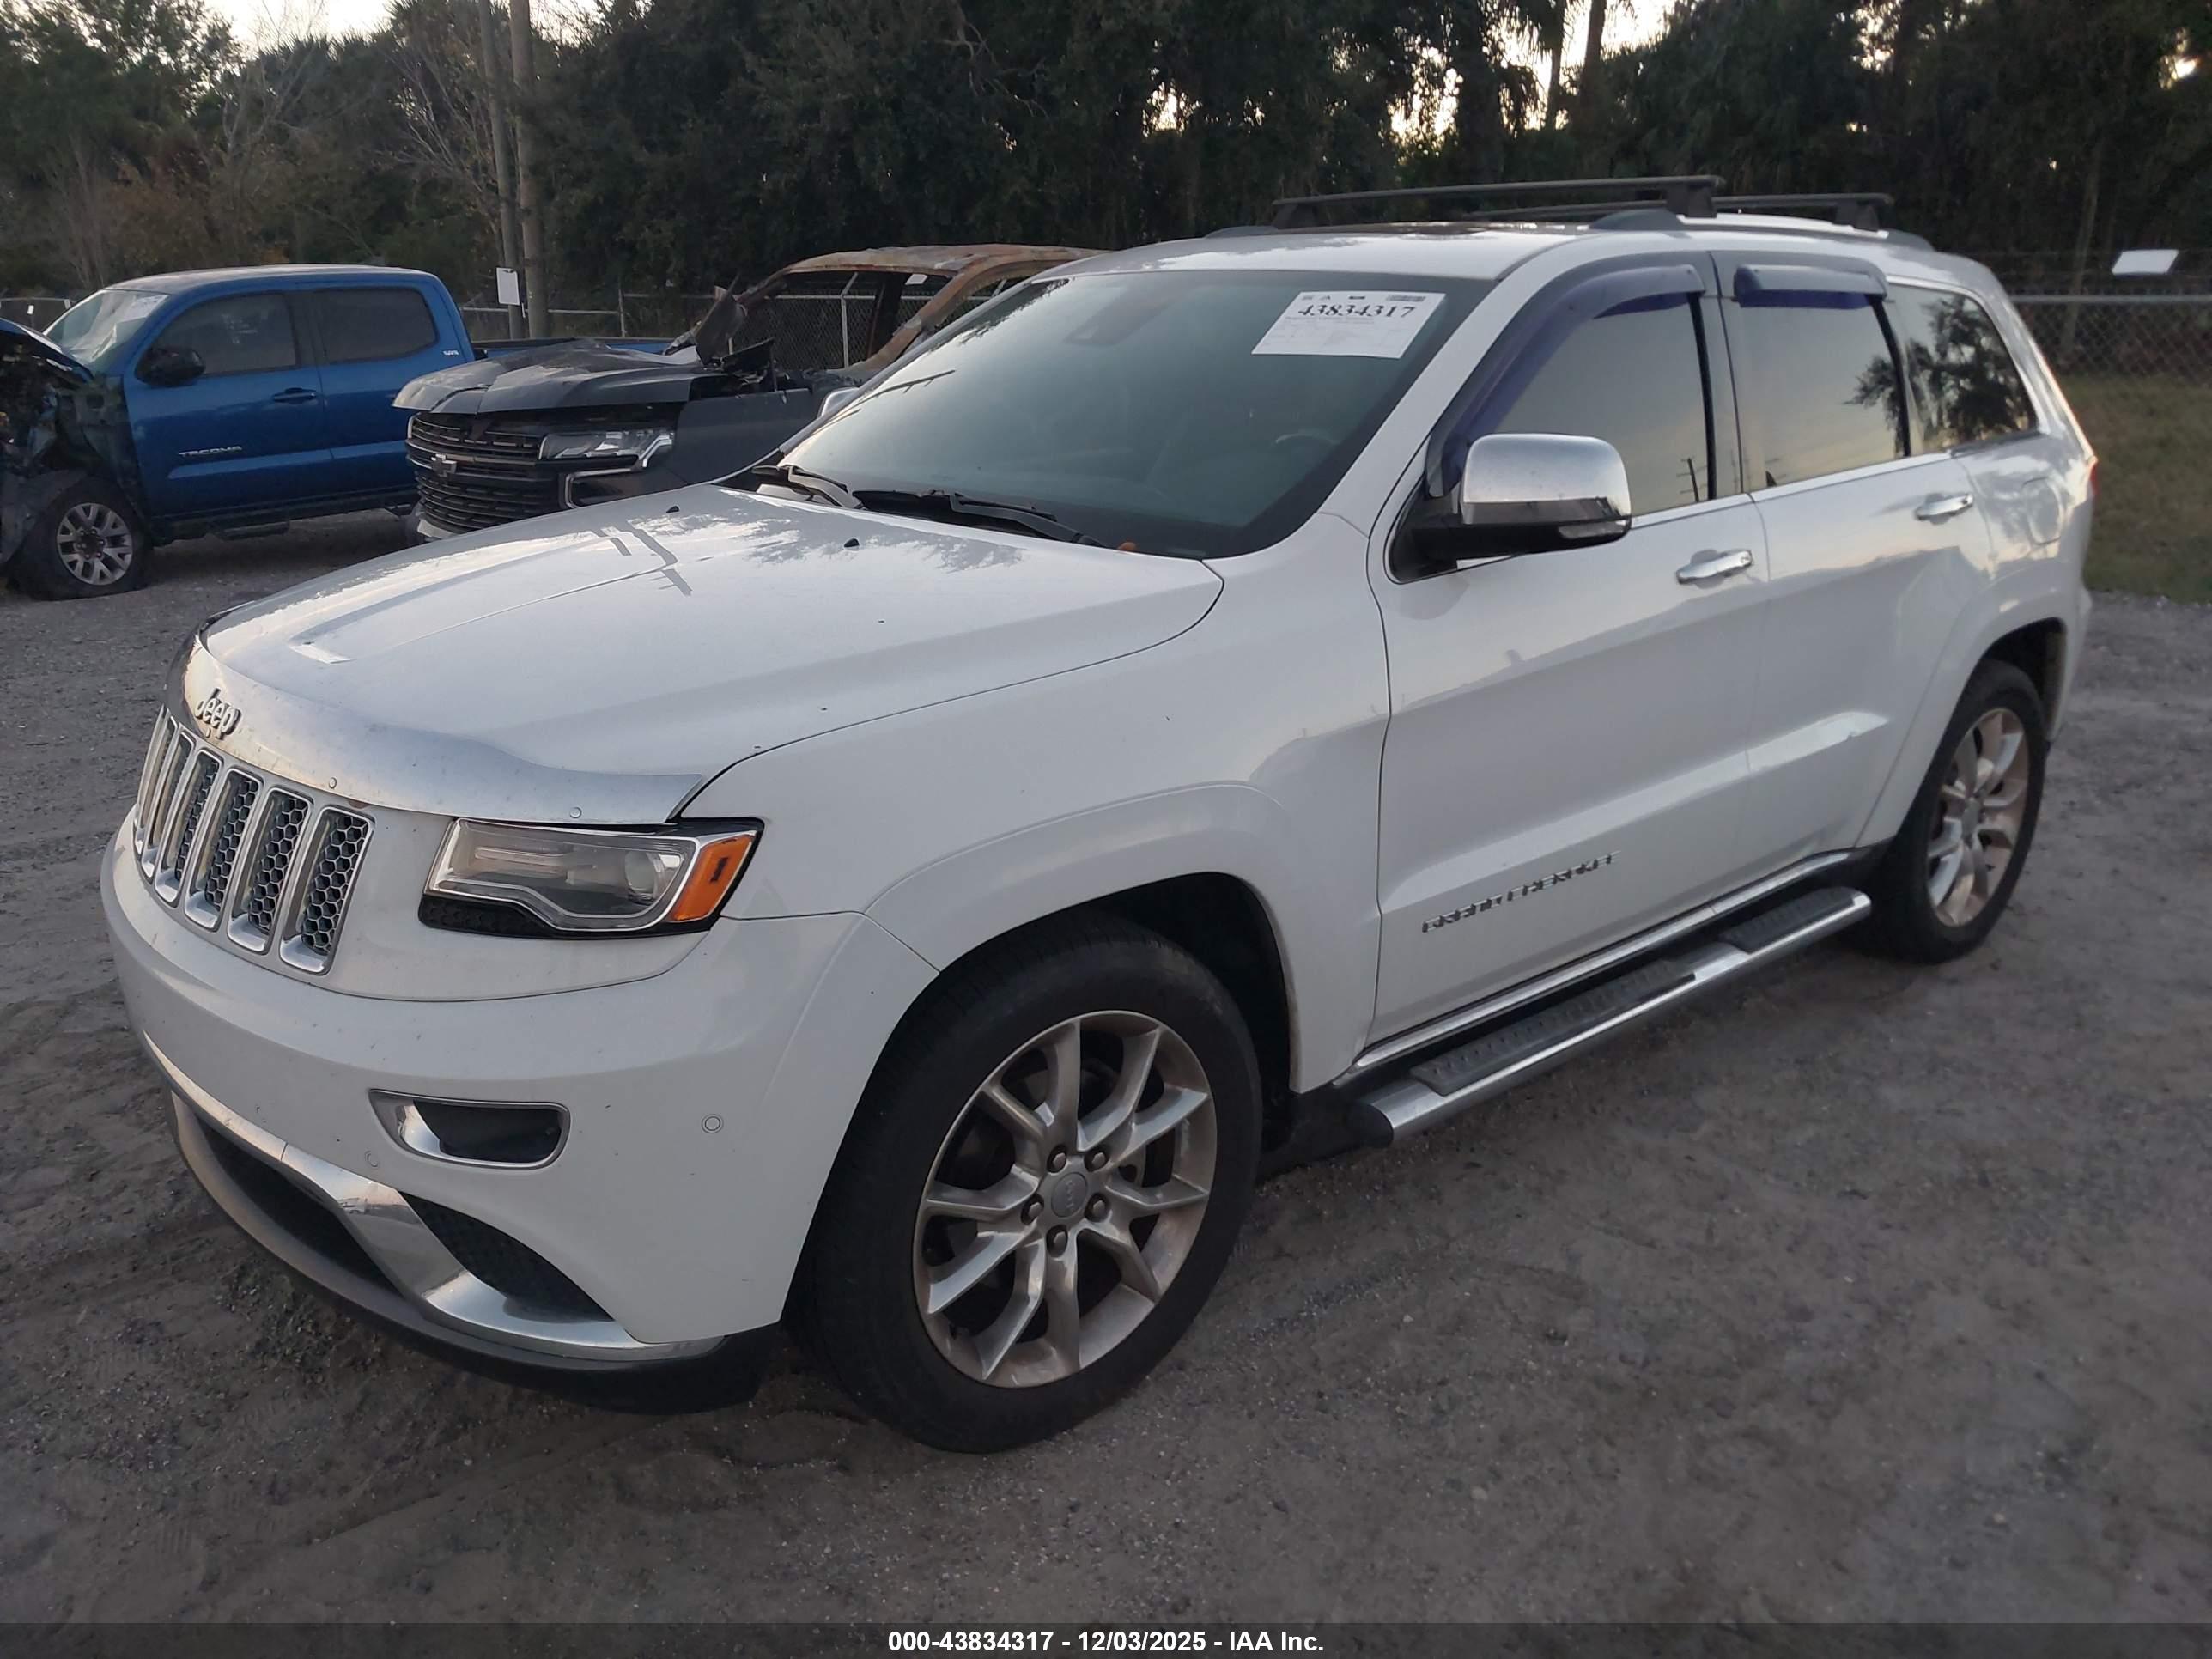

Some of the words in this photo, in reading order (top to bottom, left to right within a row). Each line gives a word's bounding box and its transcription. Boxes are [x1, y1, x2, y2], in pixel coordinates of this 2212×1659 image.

[1298, 303, 1416, 318] 43834317
[178, 445, 243, 458] TACOMA
[194, 686, 243, 740] Jeep
